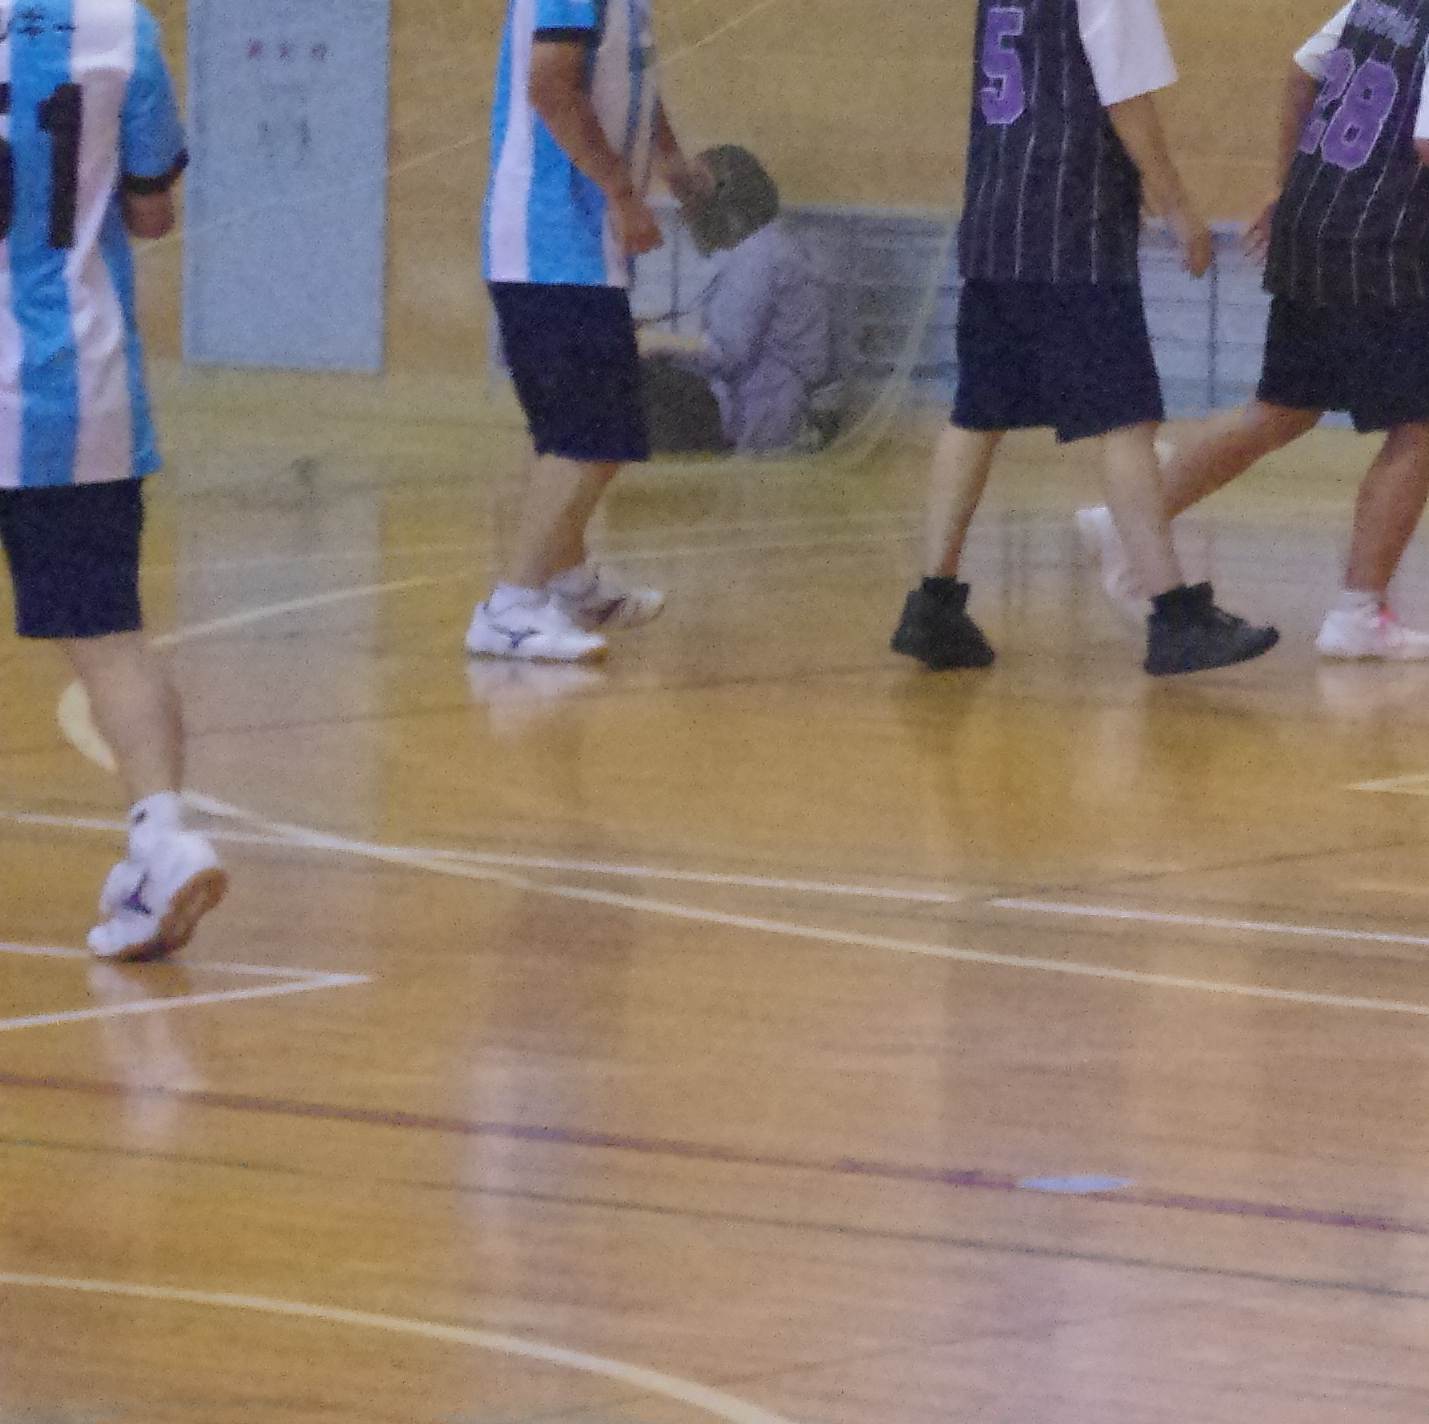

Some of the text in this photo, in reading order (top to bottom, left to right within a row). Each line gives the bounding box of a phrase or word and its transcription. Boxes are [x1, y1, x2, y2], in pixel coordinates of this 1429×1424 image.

[980, 6, 1026, 125] 5
[1297, 46, 1399, 172] 28
[0, 82, 84, 250] 1
